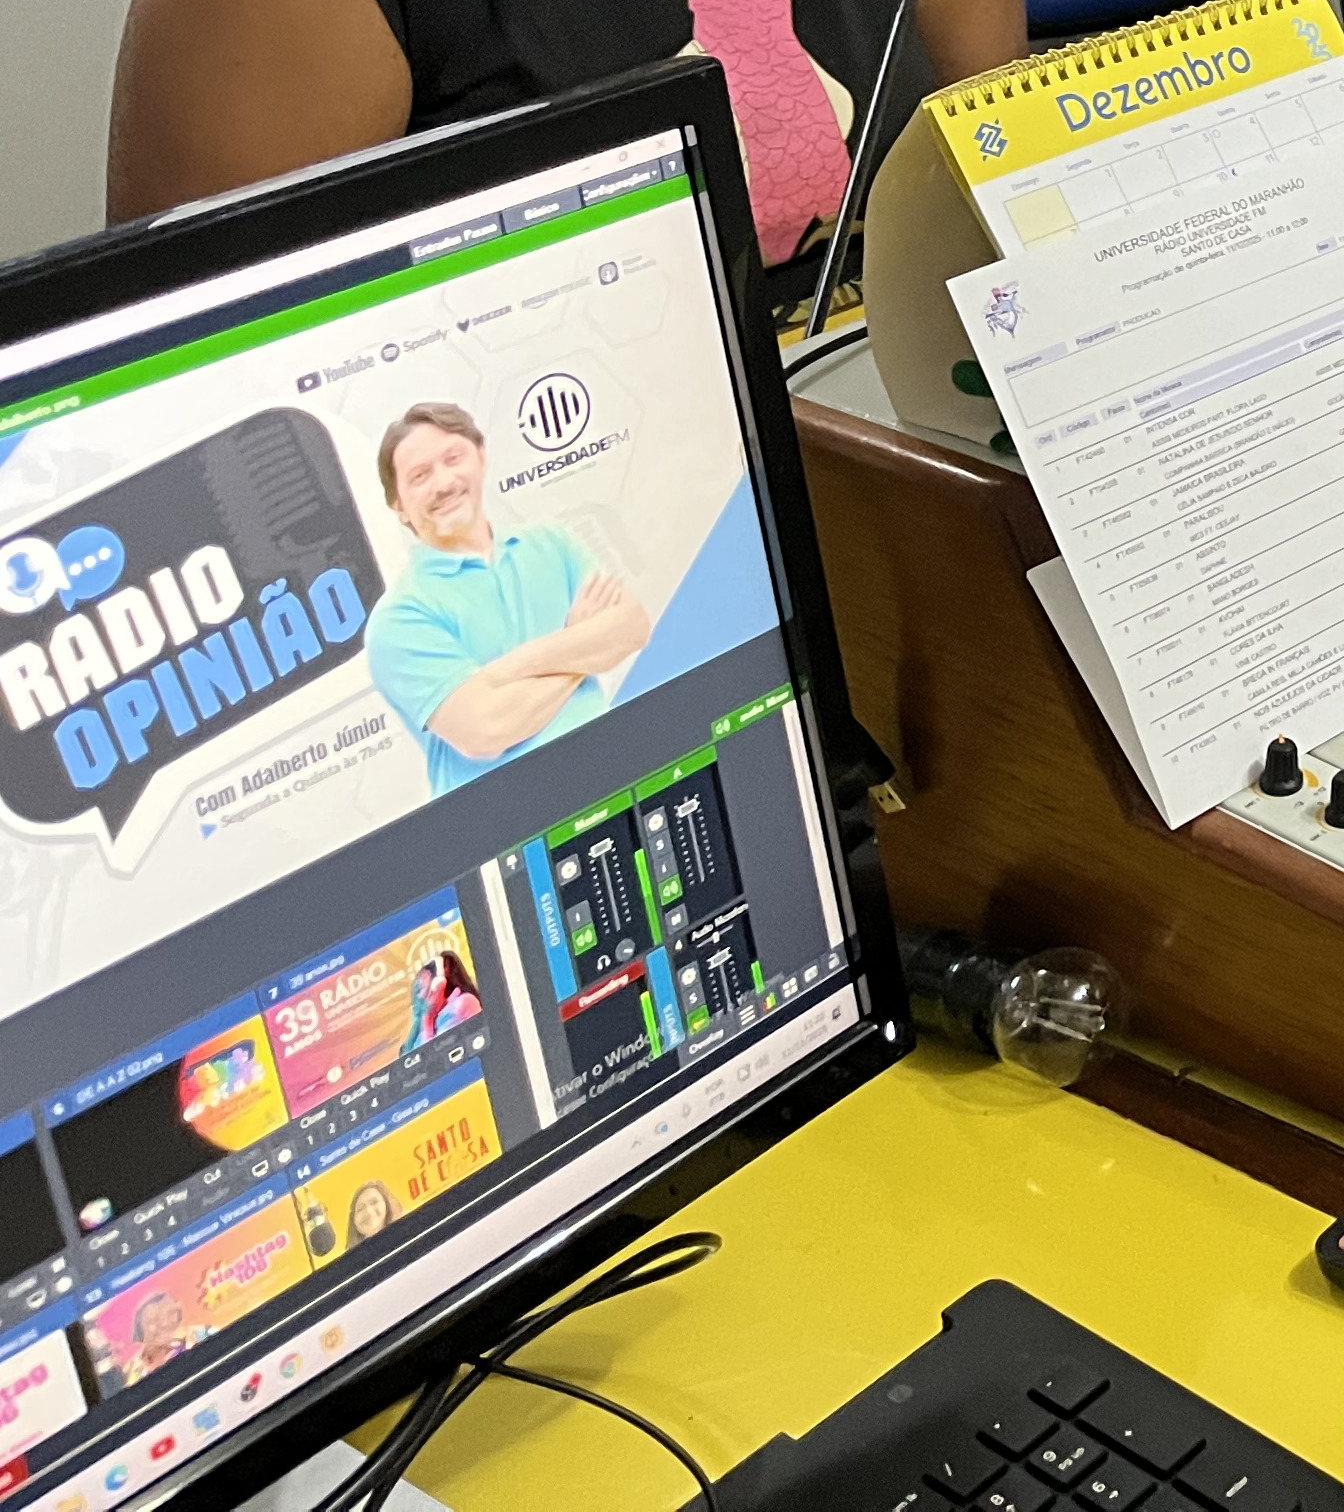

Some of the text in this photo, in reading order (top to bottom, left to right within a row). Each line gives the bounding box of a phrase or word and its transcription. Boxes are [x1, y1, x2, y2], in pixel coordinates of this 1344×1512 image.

[1056, 46, 1250, 132] Dezembro
[1094, 176, 1304, 262] UNIVERSIDADE FEDERAL DO MARANHÃO
[1180, 224, 1251, 257] SANTO DE CASA
[324, 328, 448, 383] YouTube Spotify
[499, 428, 630, 493] UNIVERSIDADEFM
[54, 568, 366, 790] OPINIÃO
[195, 712, 387, 817] Com Adalberto Júnior
[221, 791, 280, 828] Segunda
[295, 763, 341, 793] Quinta
[275, 961, 386, 1042] 39 RÁDIO
